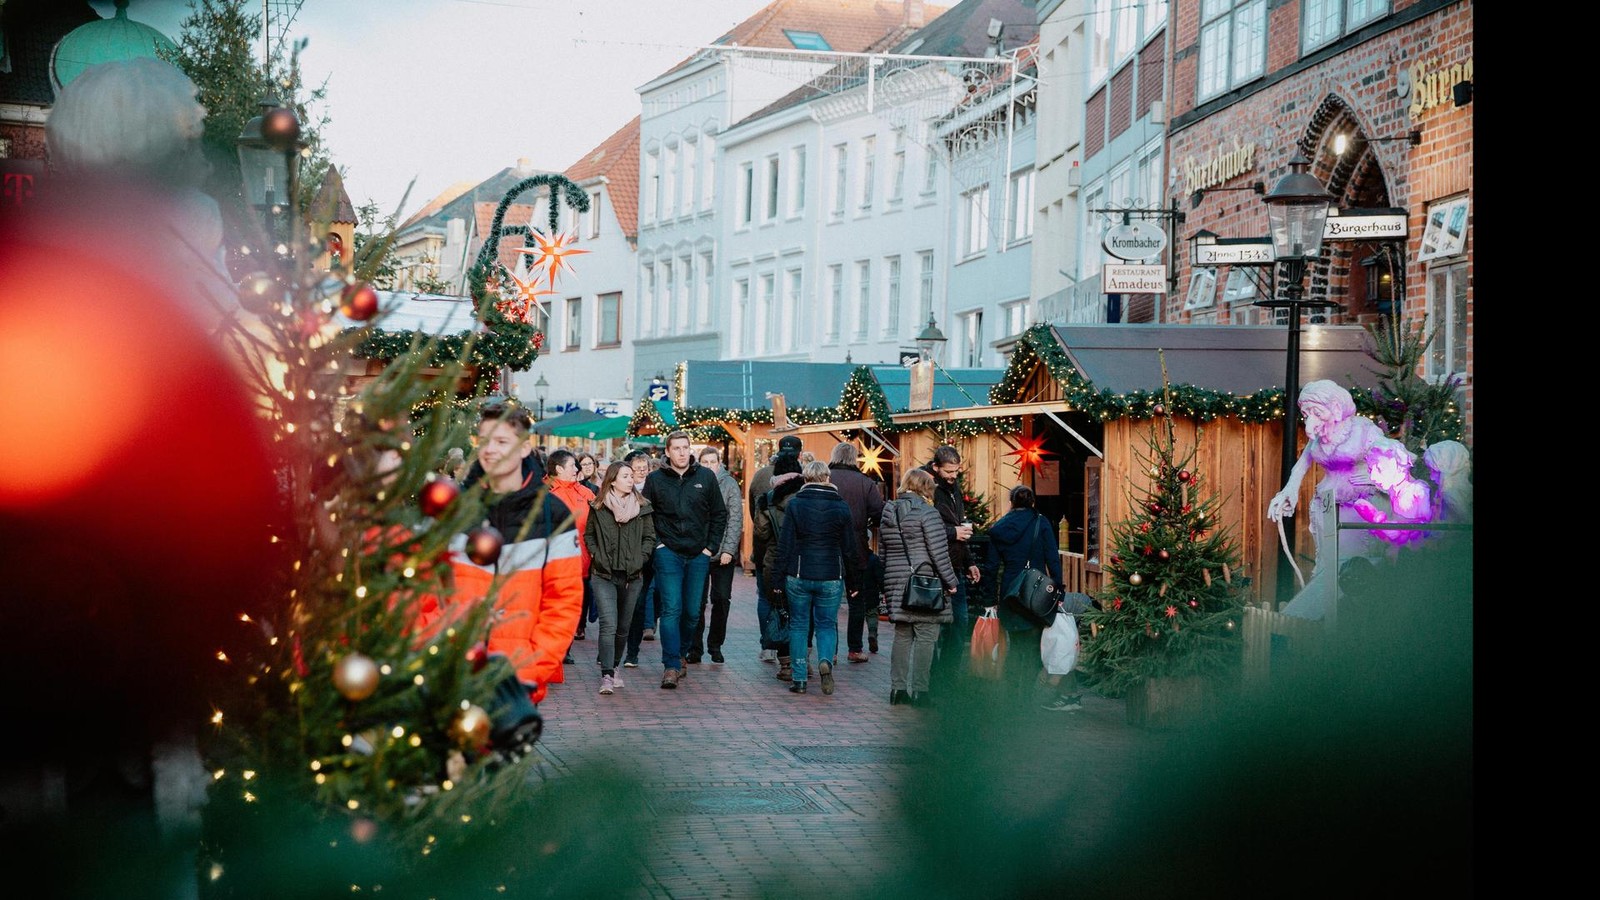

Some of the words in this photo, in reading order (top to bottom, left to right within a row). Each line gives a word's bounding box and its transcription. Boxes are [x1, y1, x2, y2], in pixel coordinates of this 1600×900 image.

[1112, 236, 1161, 248] Krombacher
[1239, 249, 1270, 262] 1548
[1108, 278, 1164, 290] Amadeus
